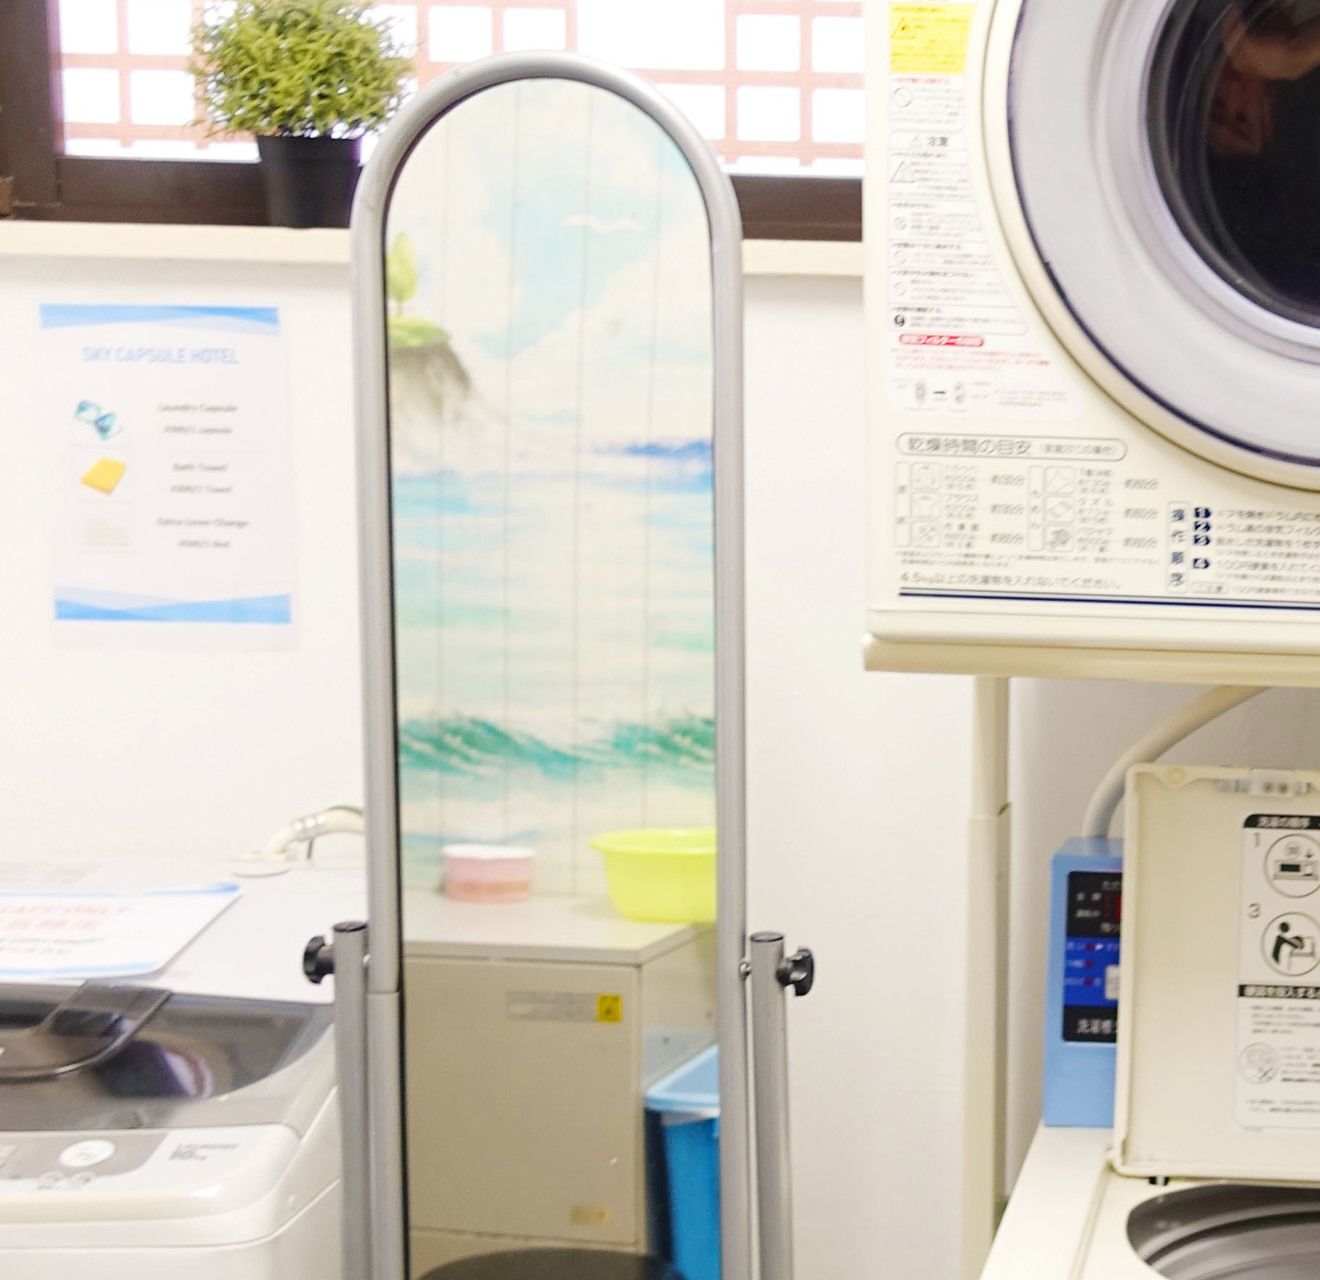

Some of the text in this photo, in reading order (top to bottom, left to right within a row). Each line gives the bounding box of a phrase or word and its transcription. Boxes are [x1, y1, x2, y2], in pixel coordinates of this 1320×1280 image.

[82, 346, 240, 364] SKY CAPSULE HOTEL
[1250, 903, 1262, 919] 3
